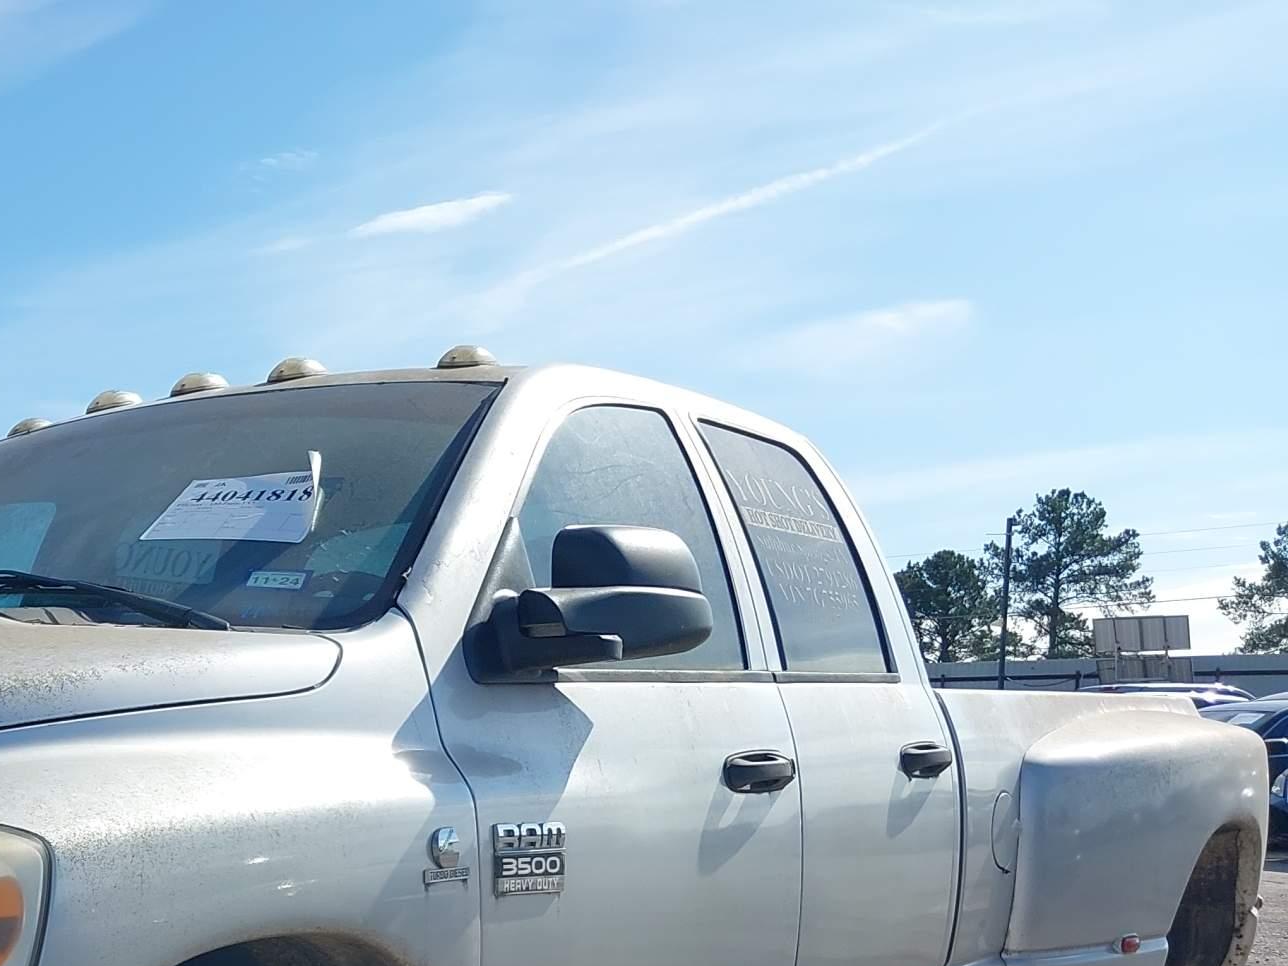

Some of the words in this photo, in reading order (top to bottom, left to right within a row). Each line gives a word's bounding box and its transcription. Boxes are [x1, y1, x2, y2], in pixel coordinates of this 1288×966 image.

[191, 485, 314, 503] 44041818
[496, 821, 566, 850] RAM
[502, 856, 561, 876] 3500
[503, 879, 534, 892] HEAVY
[536, 877, 559, 890] DUTY
